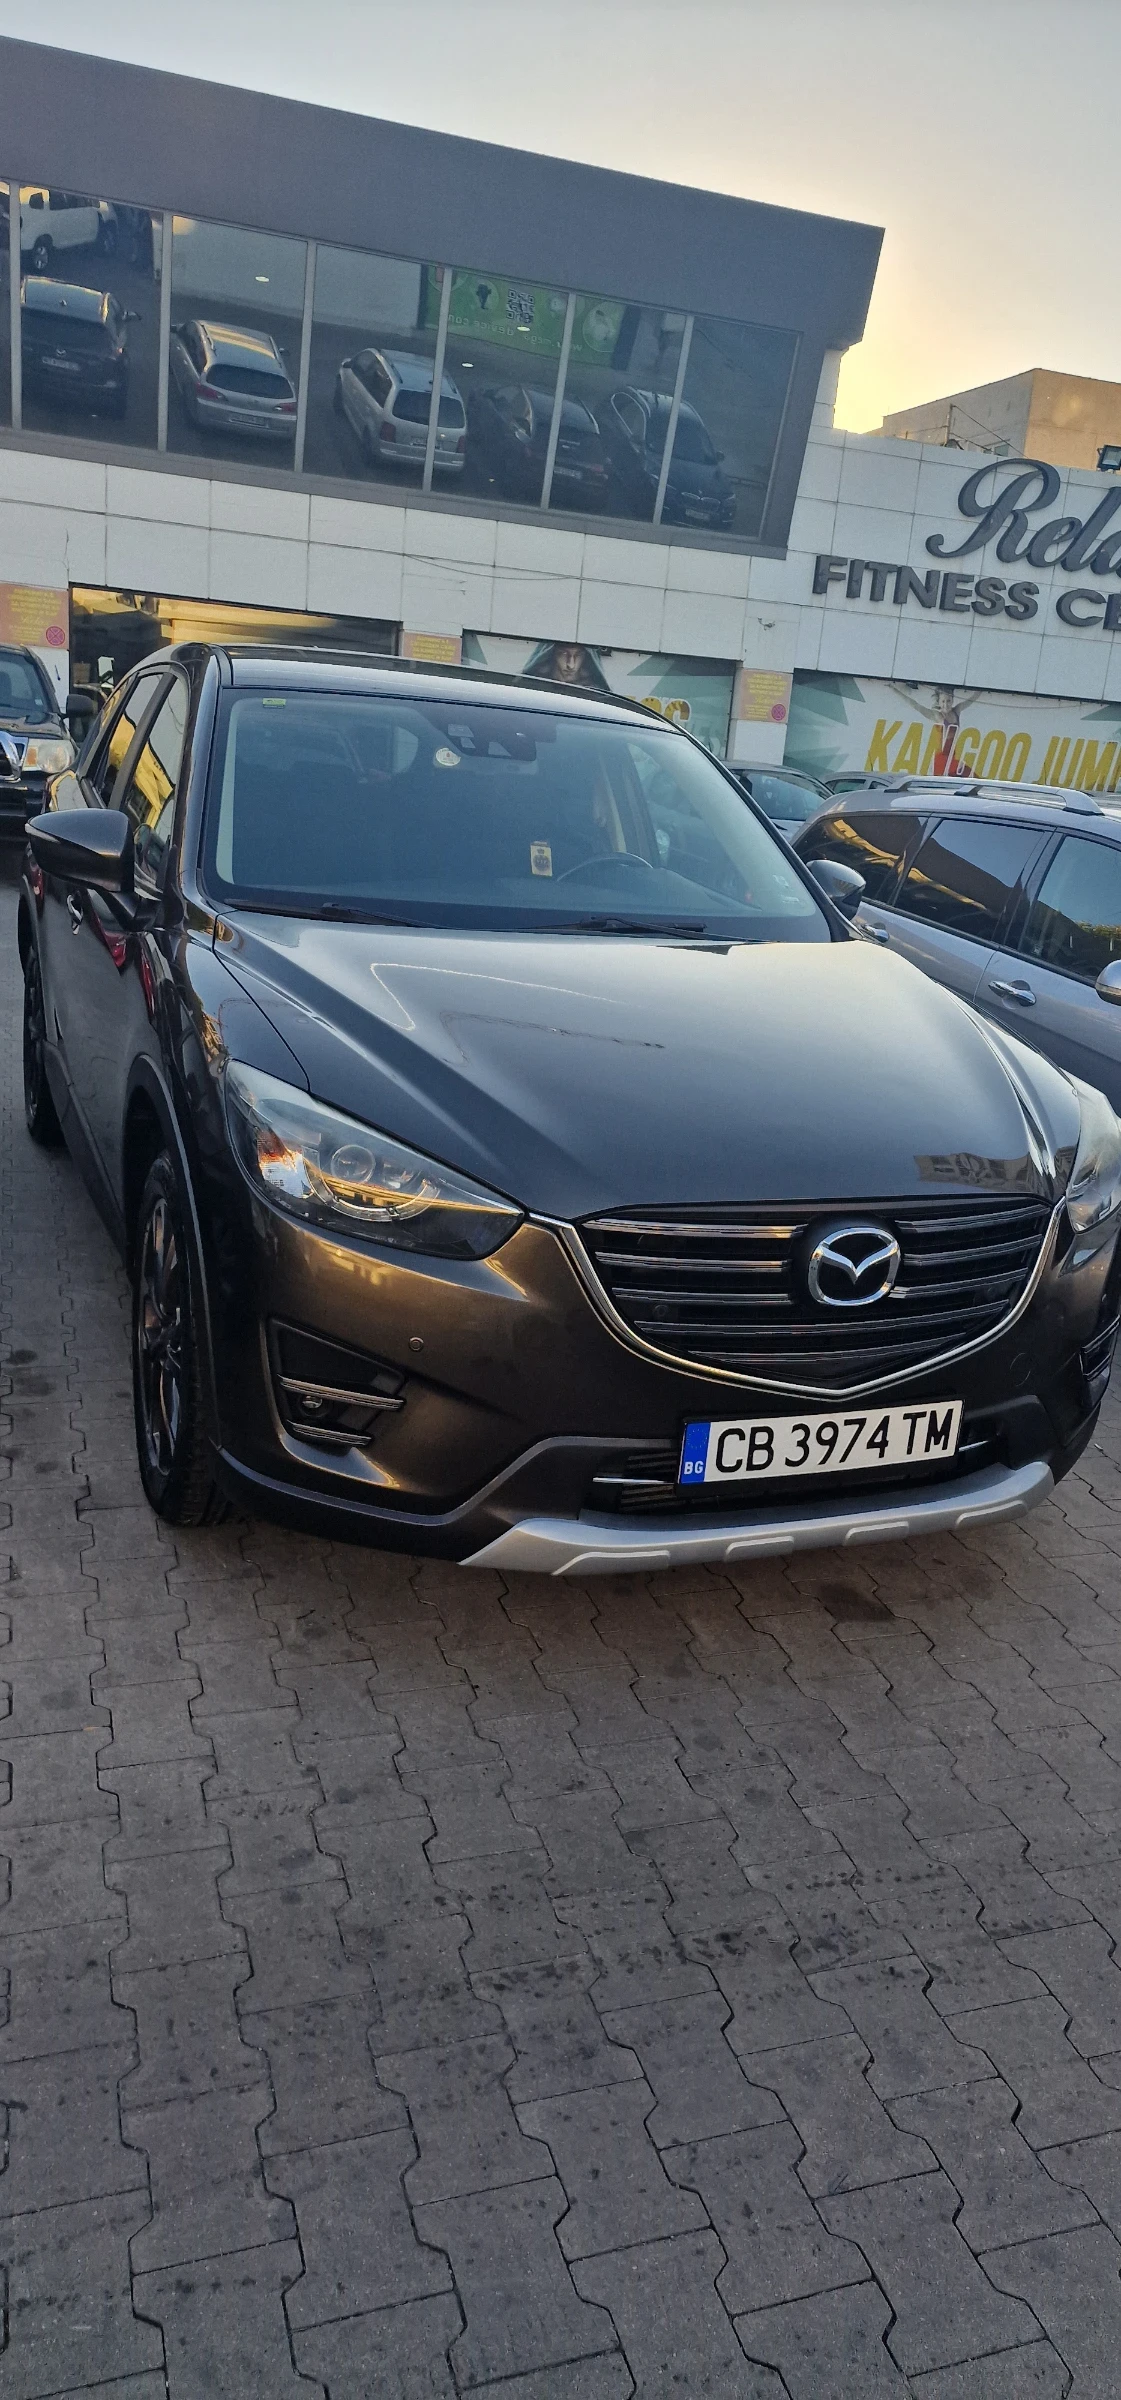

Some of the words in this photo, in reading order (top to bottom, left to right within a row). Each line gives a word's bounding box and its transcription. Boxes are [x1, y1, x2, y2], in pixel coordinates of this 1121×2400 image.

[812, 555, 1039, 620] FITNESS
[864, 719, 1032, 783] KANGOO
[683, 1460, 704, 1475] BG
[715, 1426, 775, 1473] CB
[785, 1415, 891, 1467] 3974
[903, 1408, 954, 1455] TM
